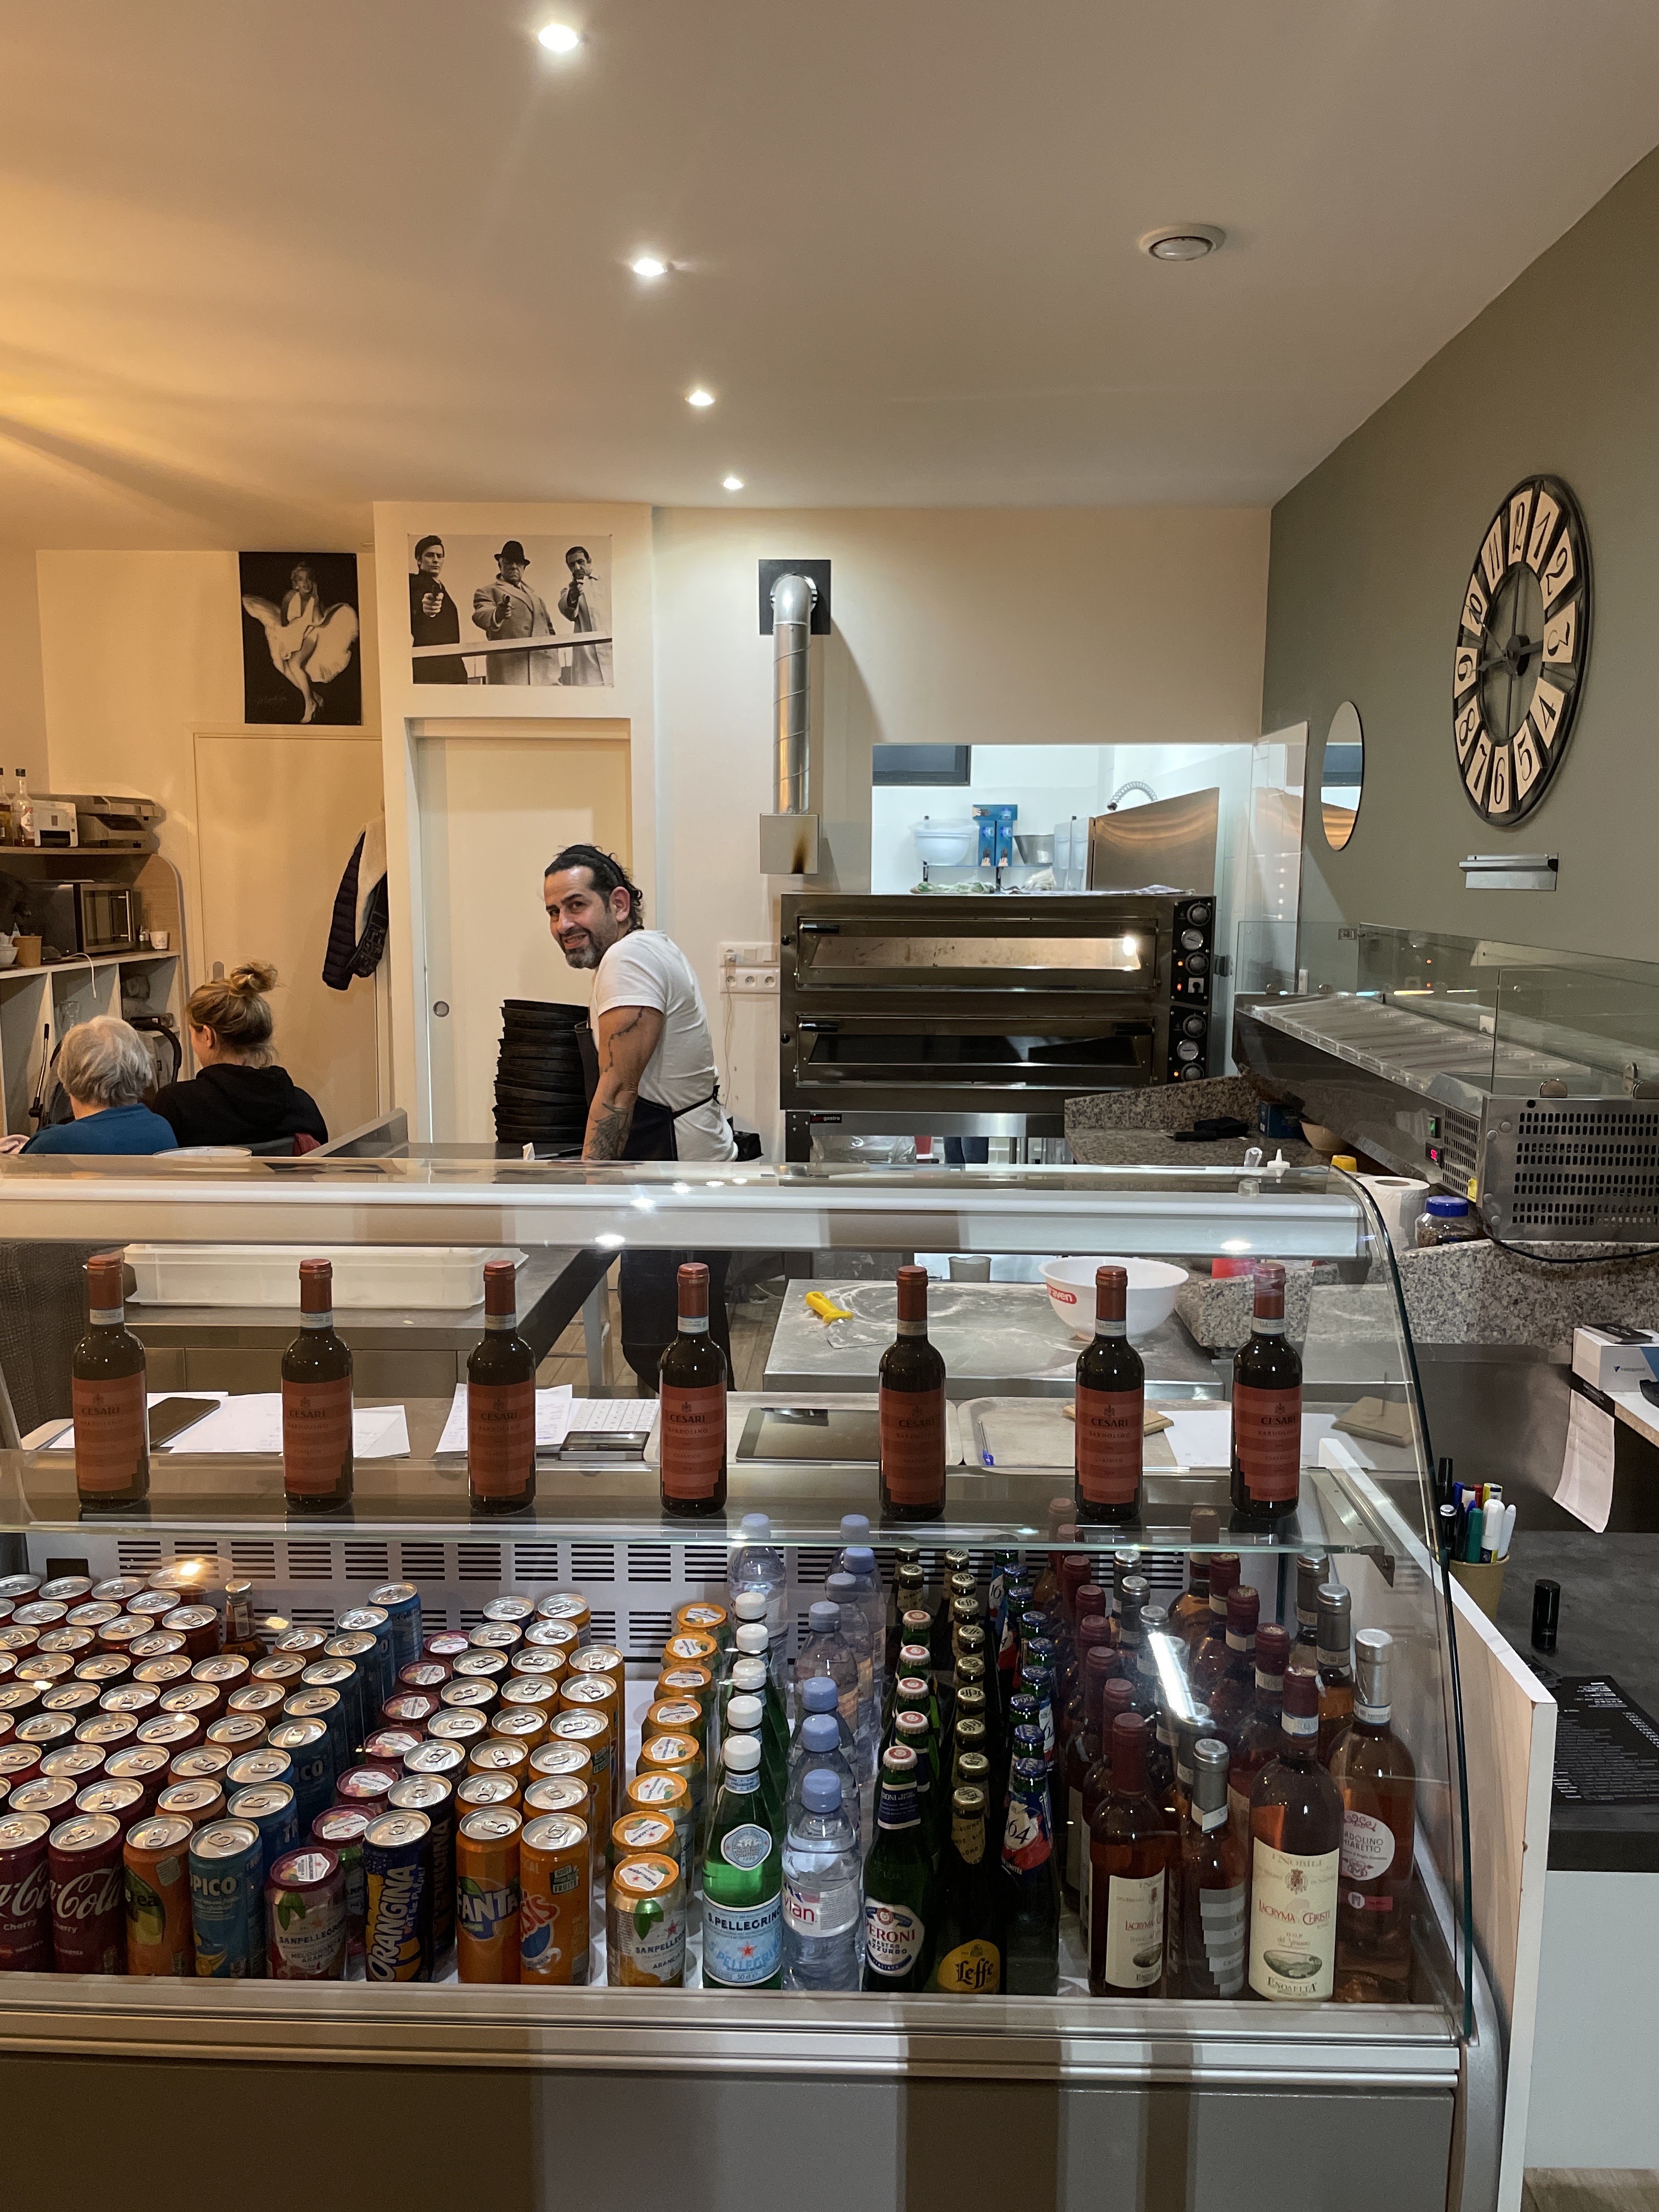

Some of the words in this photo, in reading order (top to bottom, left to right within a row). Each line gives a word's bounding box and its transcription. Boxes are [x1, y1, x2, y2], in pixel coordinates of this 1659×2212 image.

[1534, 511, 1551, 560] 1
[1546, 546, 1568, 595] 2
[1546, 622, 1571, 658] 3
[1457, 653, 1474, 679] 9
[1538, 695, 1557, 723] 4
[1459, 707, 1475, 740] 8
[1472, 743, 1488, 793] 7
[1517, 740, 1533, 781] 5
[1493, 757, 1505, 805] 6
[81, 1406, 120, 1415] CESARI
[290, 1409, 325, 1419] CESARI
[481, 1411, 517, 1421] CESARI
[670, 1414, 706, 1424] CESARI
[1091, 1417, 1128, 1428] CESARI
[1261, 1415, 1296, 1425] CESARI
[668, 1426, 708, 1435] BARDOLINO
[898, 1418, 935, 1429] CESARI
[367, 1864, 417, 1982] ORANGINA
[1258, 1899, 1296, 1923] LACRYMA
[867, 1939, 907, 1955] AZZURRO
[872, 1938, 901, 1949] NASTRO
[954, 1957, 994, 1990] Leffe
